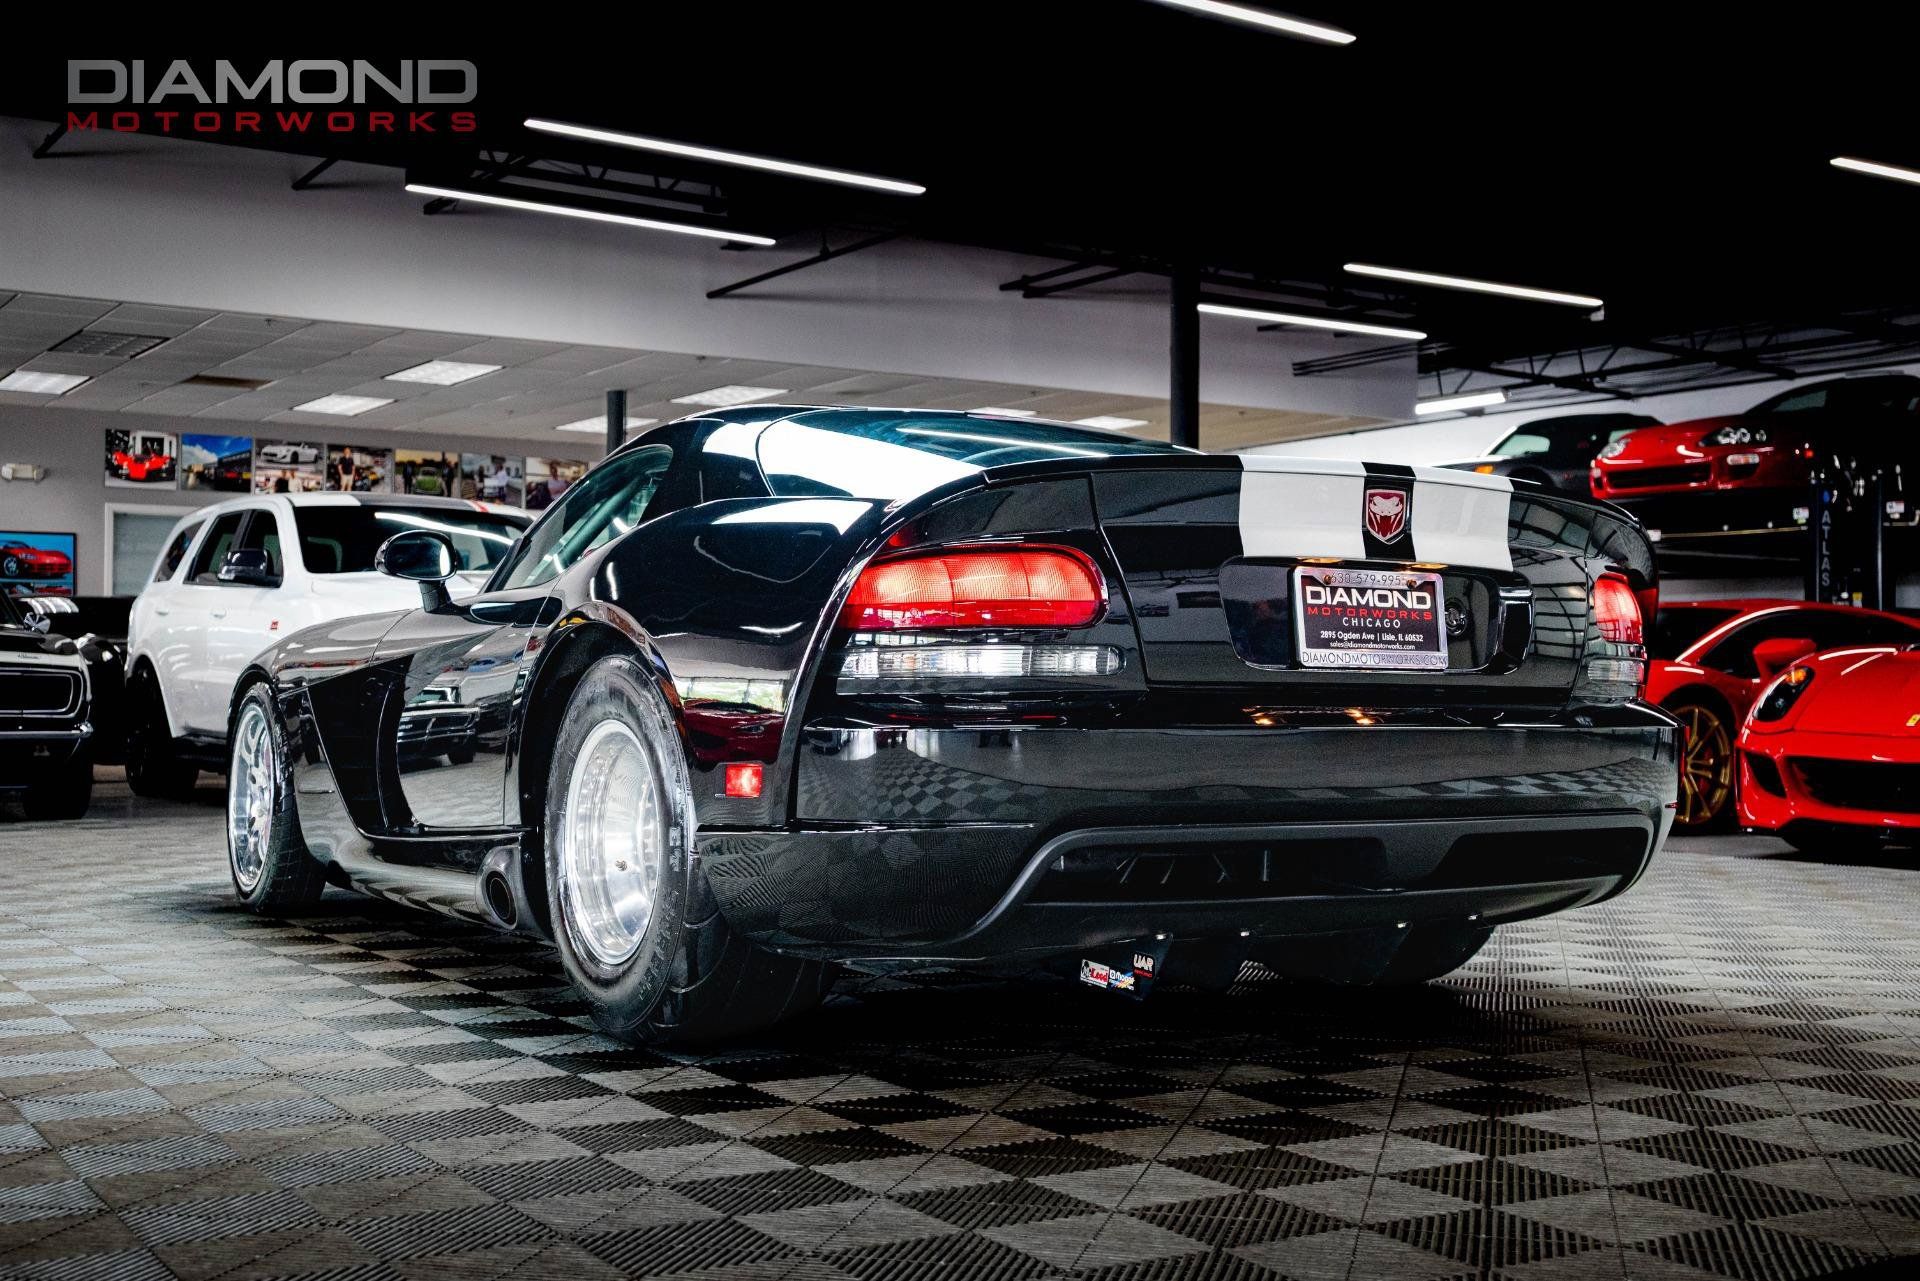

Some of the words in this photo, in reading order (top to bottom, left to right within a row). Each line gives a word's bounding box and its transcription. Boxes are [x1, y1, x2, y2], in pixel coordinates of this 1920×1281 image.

[1821, 510, 1832, 587] ATLAS
[1305, 586, 1431, 610] DIAMOND
[1307, 607, 1433, 620] MOTORWORKS
[1342, 617, 1401, 628] CHICAGO
[1320, 630, 1336, 639] 2895
[1337, 631, 1361, 641] Ogden
[1361, 632, 1375, 640] Ave
[1405, 634, 1424, 642] 60532
[1330, 641, 1416, 651] sales@diamondmotorworks.com
